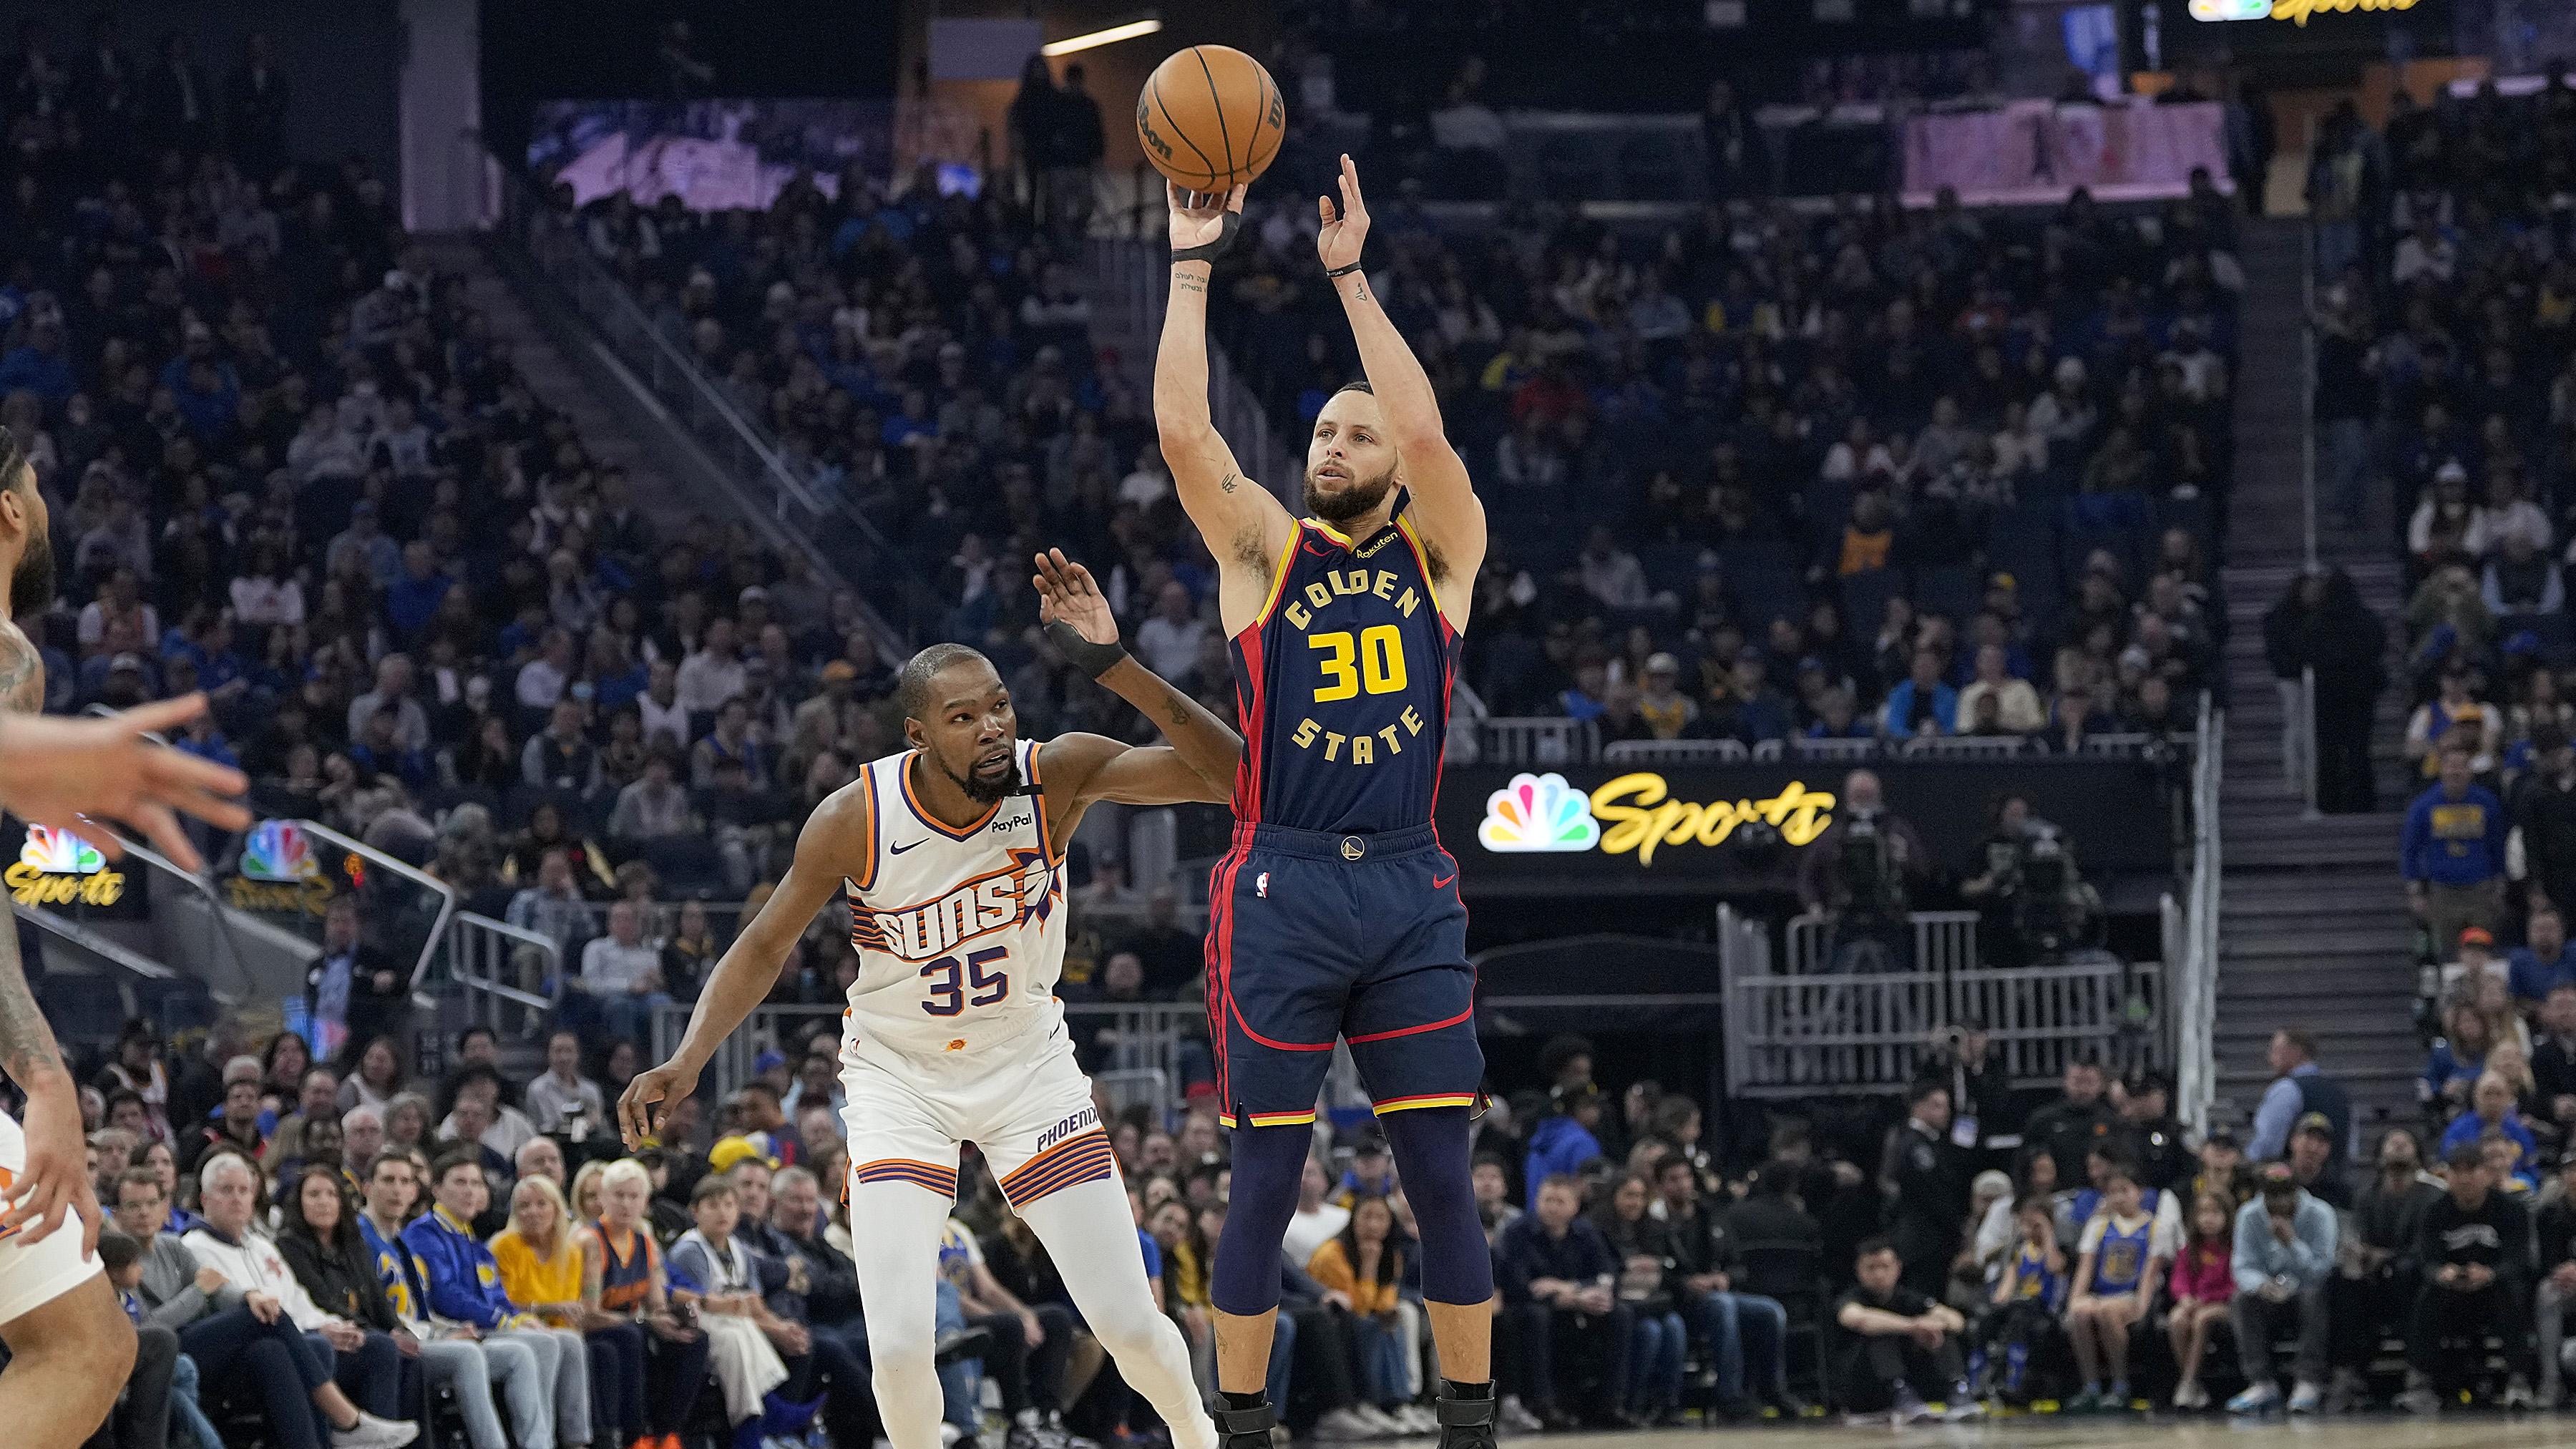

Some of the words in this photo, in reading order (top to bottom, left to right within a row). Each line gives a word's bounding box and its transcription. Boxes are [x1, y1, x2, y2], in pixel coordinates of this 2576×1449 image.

[1356, 532, 1398, 559] Rakuten
[1284, 569, 1420, 630] GOLDEN
[1308, 624, 1407, 703] 30
[1292, 704, 1424, 765] STATE
[992, 813, 1033, 833] PayPal
[1591, 772, 1836, 867] Sports
[4, 861, 126, 909] Sports
[874, 874, 1018, 960] SUNS
[920, 945, 1010, 1018] 35
[1037, 1106, 1098, 1153] PHOENIX
